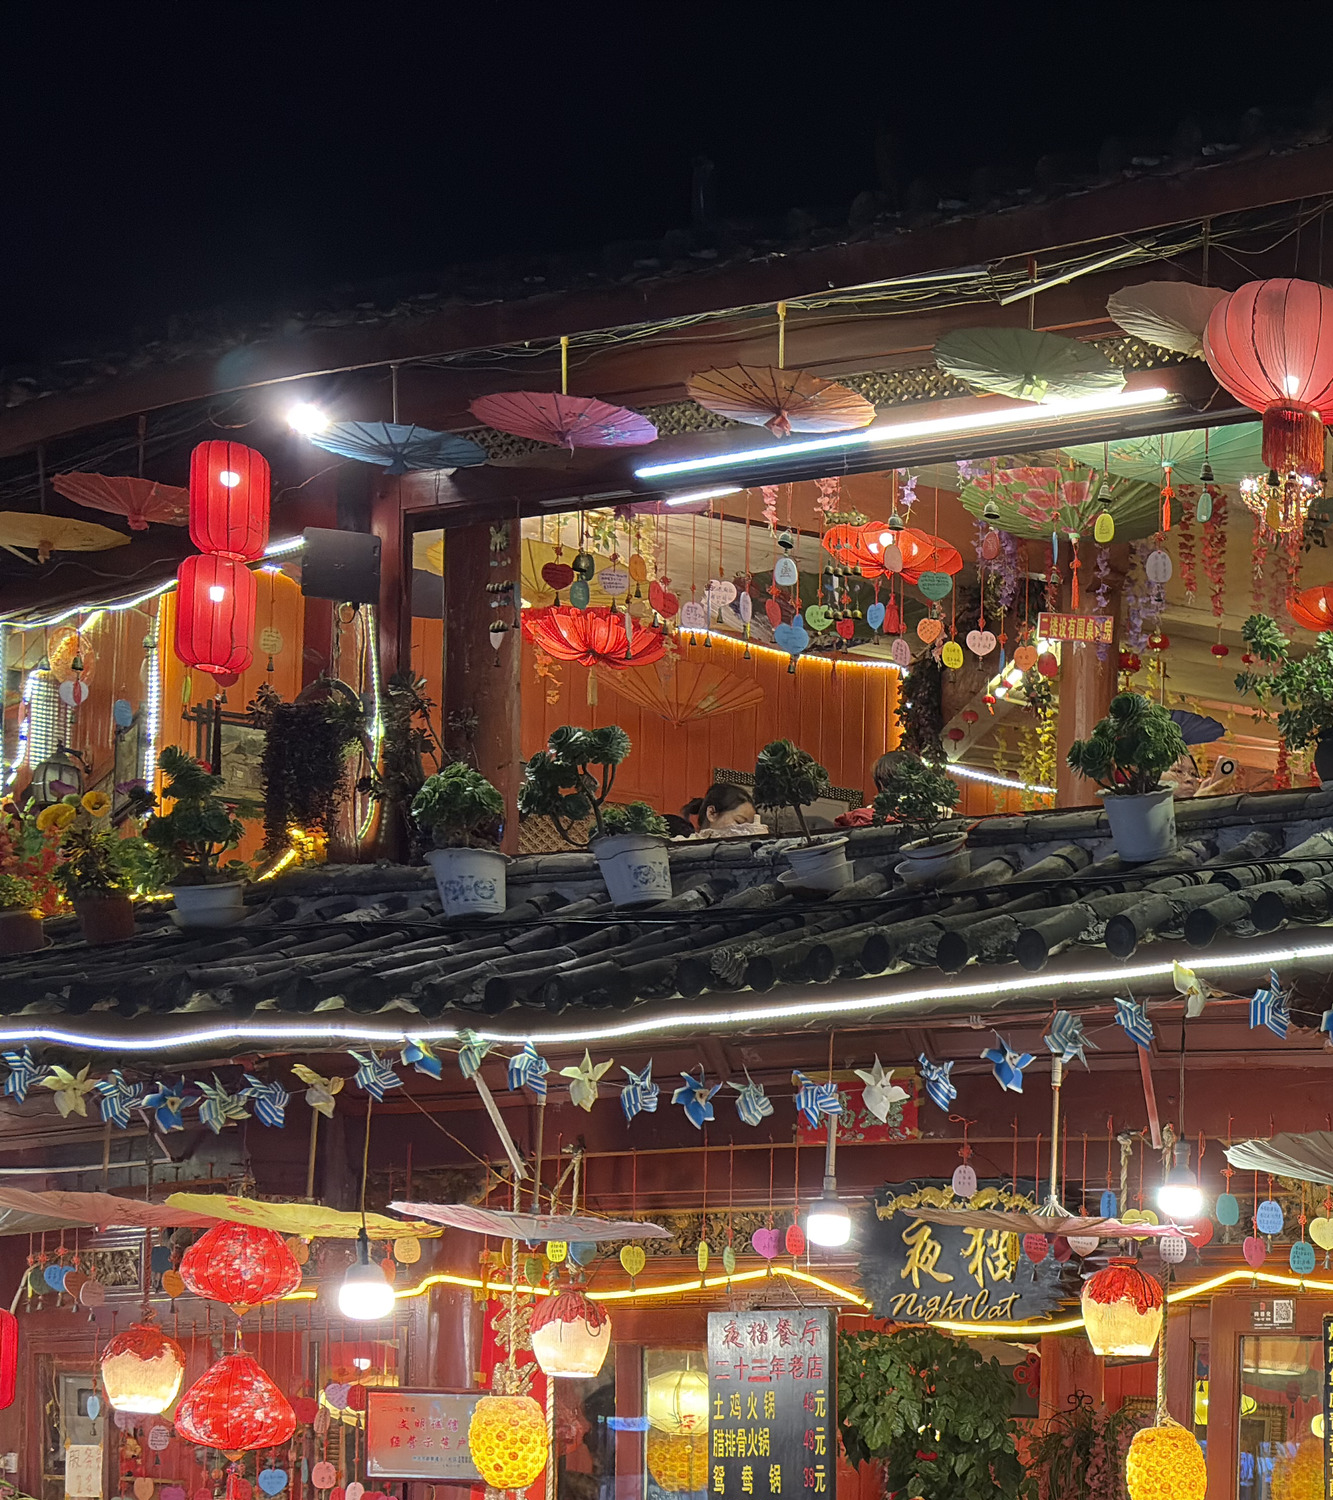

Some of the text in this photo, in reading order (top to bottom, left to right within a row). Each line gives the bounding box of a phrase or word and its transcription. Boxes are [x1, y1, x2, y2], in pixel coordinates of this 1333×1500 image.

[723, 1317, 820, 1349] 夜猫餐厅
[713, 1391, 775, 1420] 土鸡火锅
[713, 1428, 770, 1457] 腊排骨火锅
[713, 1464, 781, 1494] 鸳鸯锅
